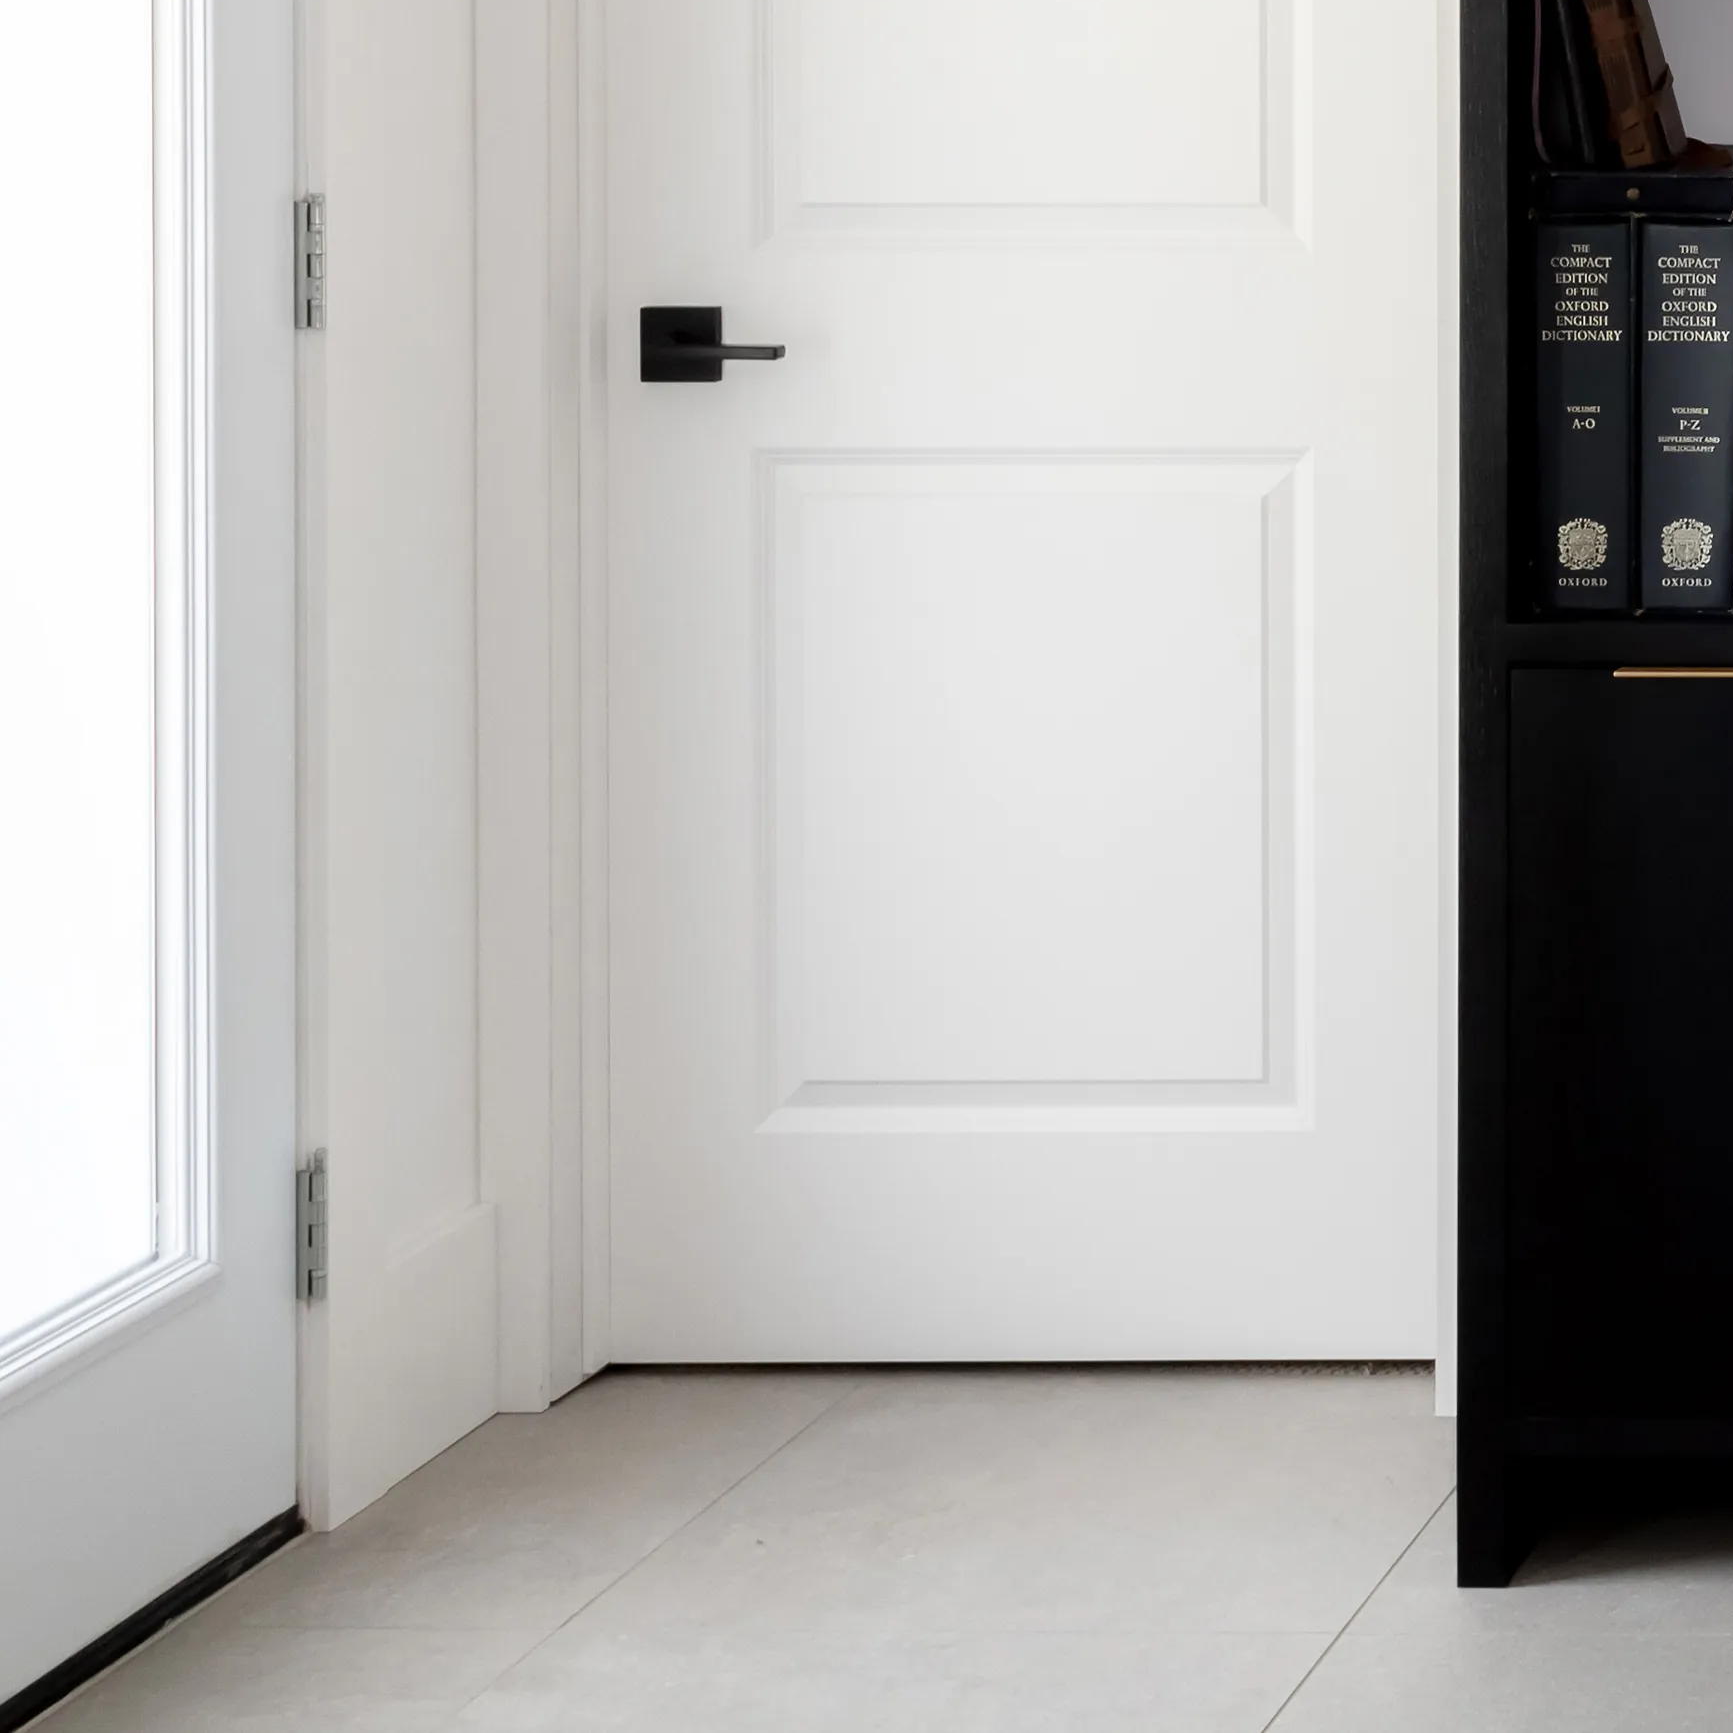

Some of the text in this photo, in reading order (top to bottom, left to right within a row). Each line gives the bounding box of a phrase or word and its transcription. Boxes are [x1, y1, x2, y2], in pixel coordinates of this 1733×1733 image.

[1572, 245, 1590, 253] THE
[1551, 257, 1611, 268] COMPACT
[1555, 273, 1608, 284] EDITION
[1565, 288, 1598, 296] OF THE
[1555, 300, 1608, 313] OXFORD
[1556, 315, 1608, 326] ENGLISH
[1541, 330, 1622, 341] DICTIONARY
[1572, 419, 1595, 429] A-O
[1558, 578, 1607, 587] OXFORD
